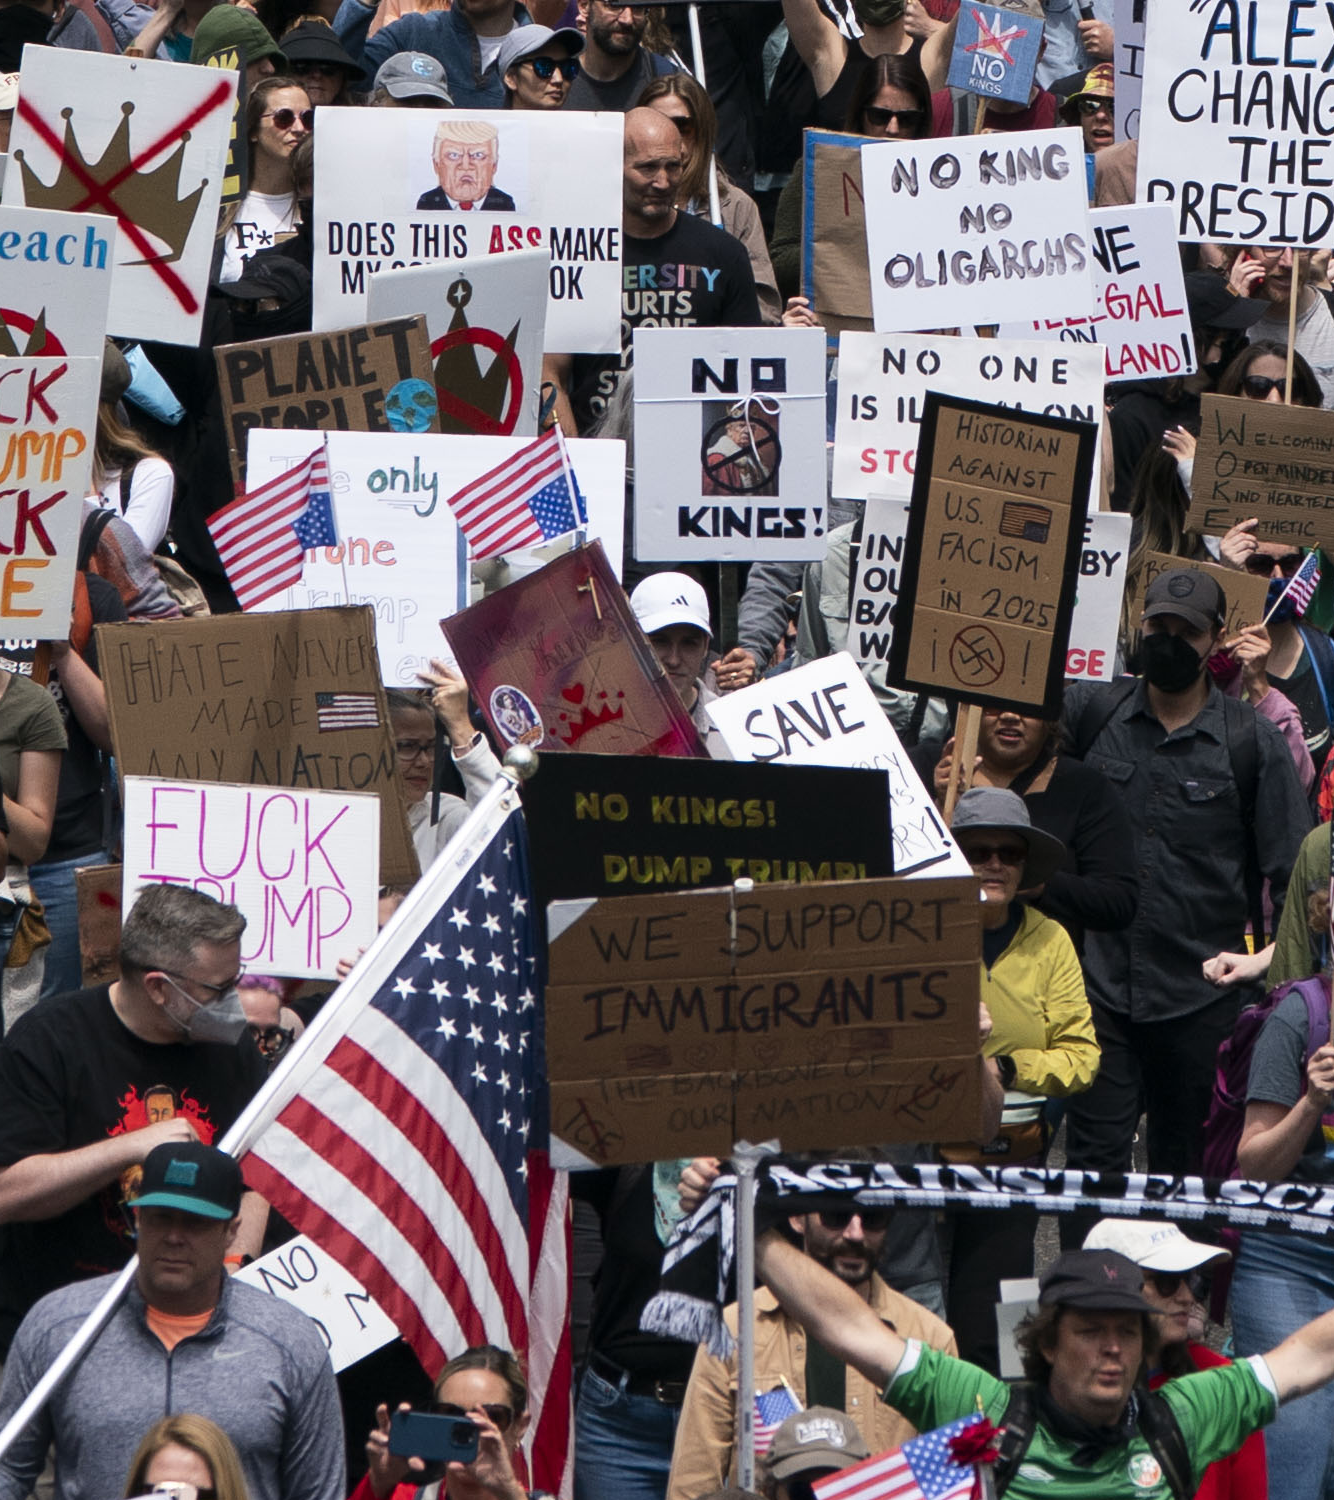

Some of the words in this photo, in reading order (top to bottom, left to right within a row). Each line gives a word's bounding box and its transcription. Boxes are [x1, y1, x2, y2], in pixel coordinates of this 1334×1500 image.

[1228, 136, 1334, 187] THE
[691, 358, 785, 393] NO
[680, 505, 824, 539] KINGS!
